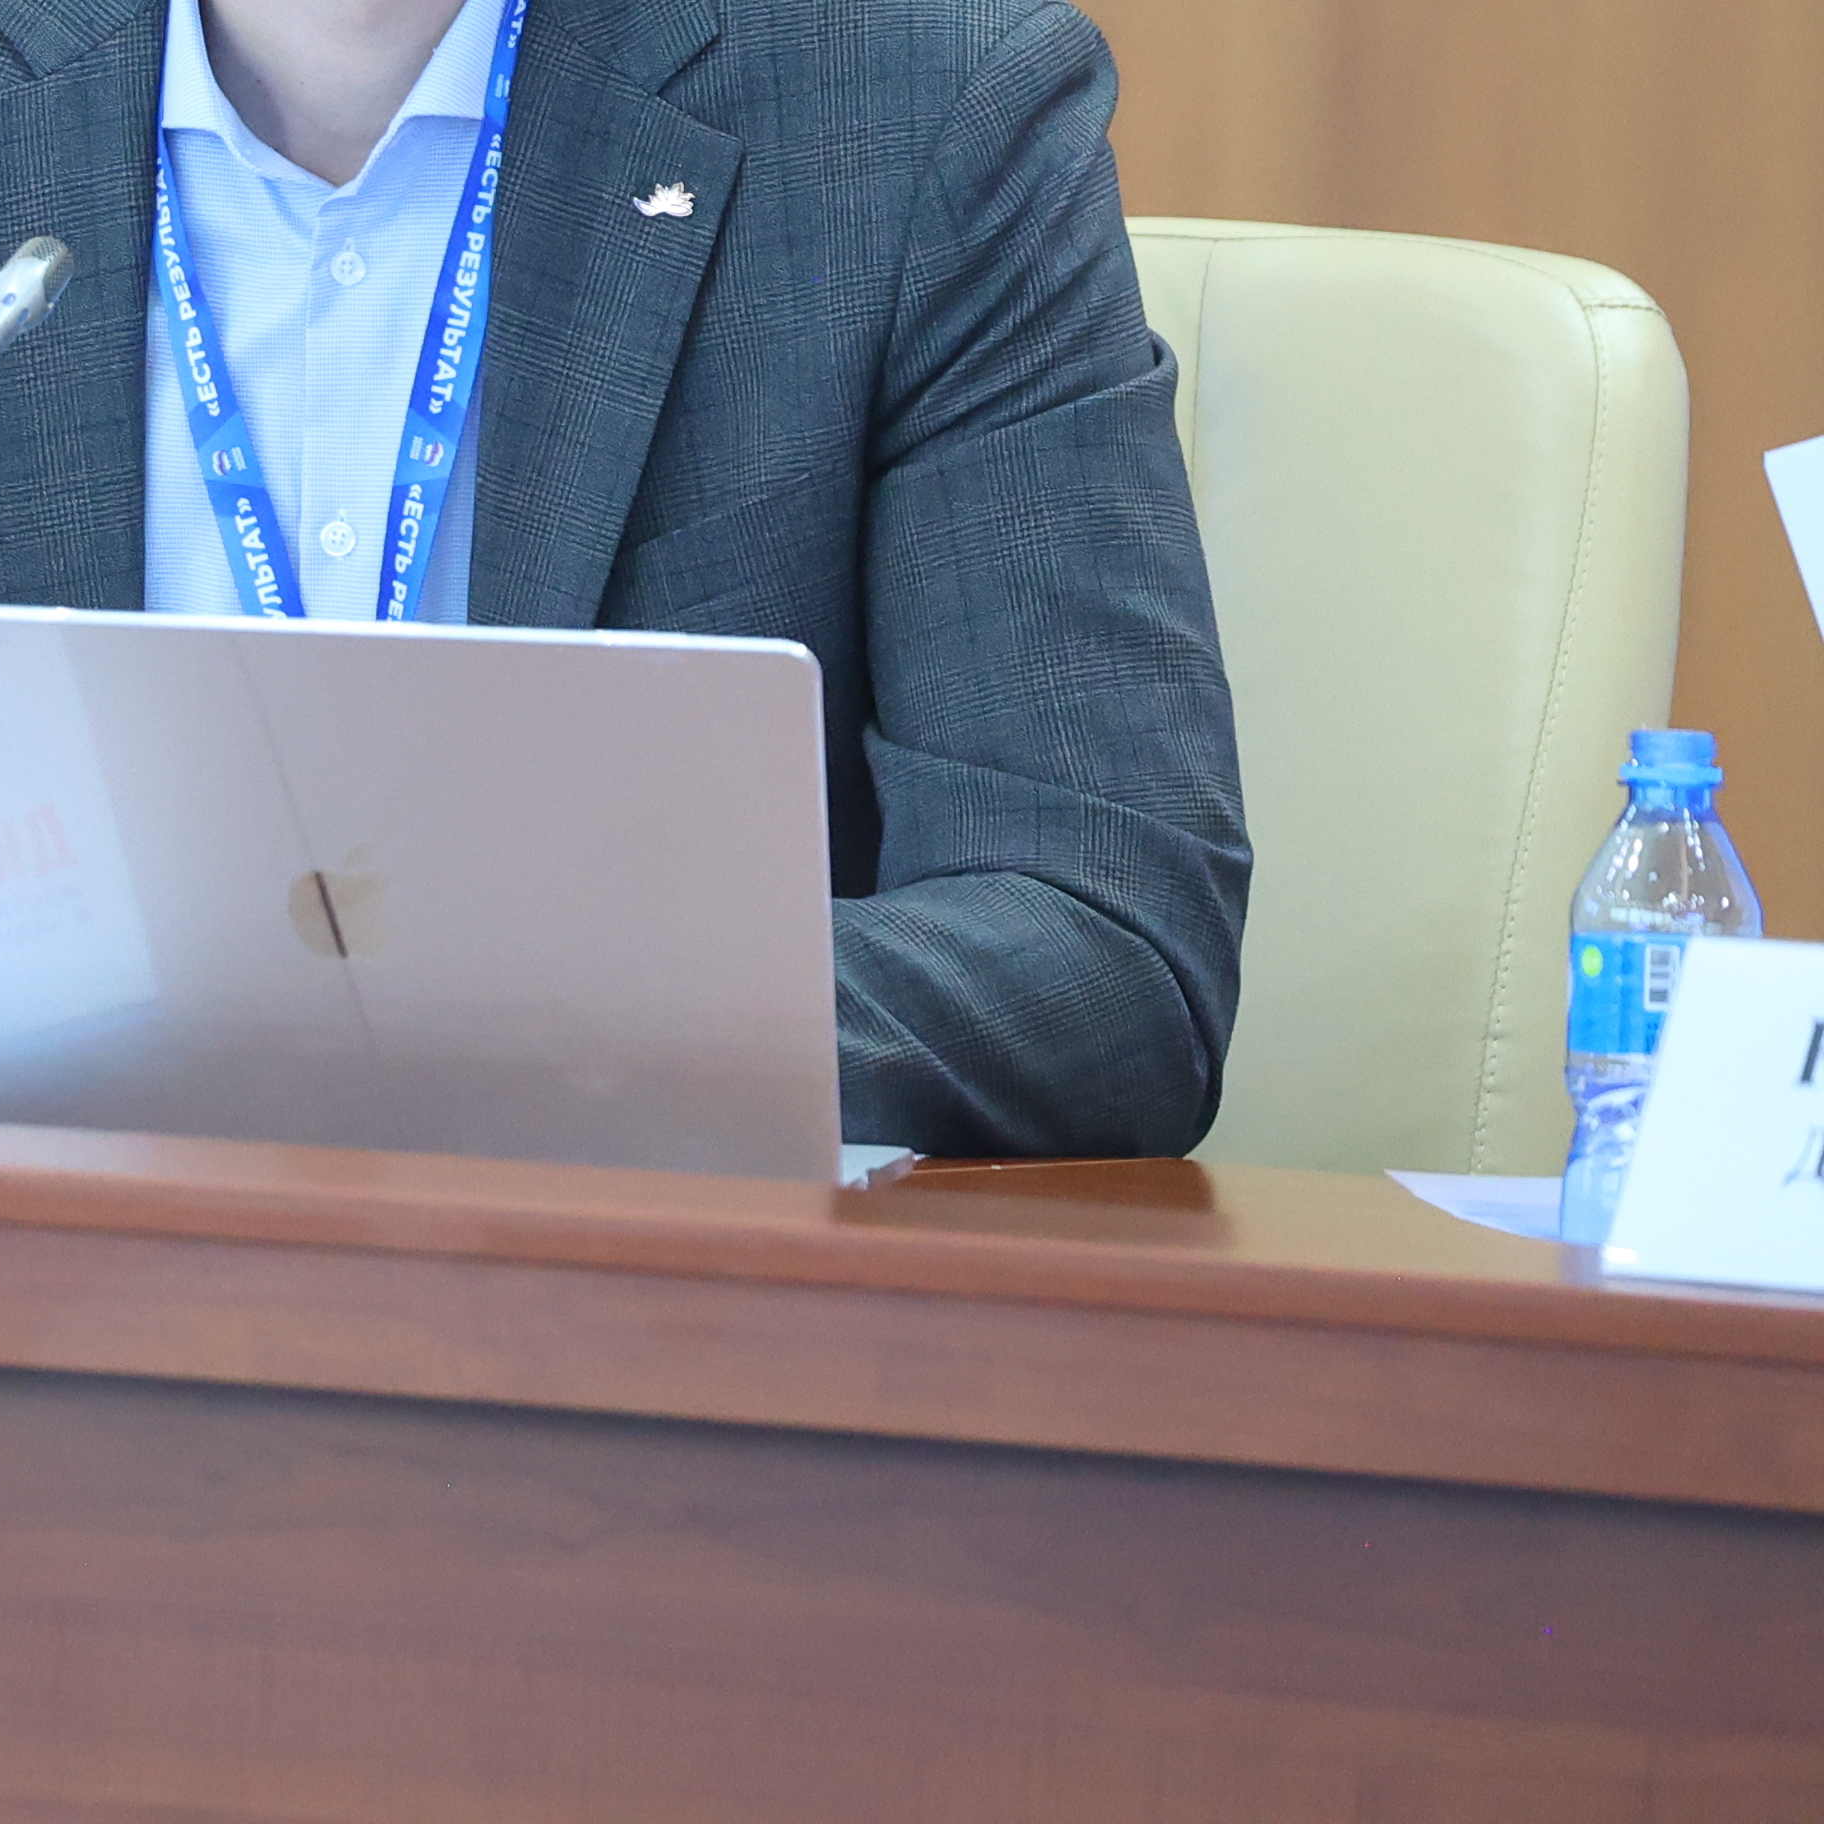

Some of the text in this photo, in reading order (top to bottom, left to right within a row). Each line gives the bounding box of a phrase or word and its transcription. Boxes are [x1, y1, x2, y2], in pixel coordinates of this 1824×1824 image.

[156, 157, 221, 417] «ЕСТЬ РЕЗУЛЬТА
[429, 133, 503, 414] «ЕСТЬ РЕЗУЛЬТАТ»
[387, 580, 408, 622] РЕ
[394, 483, 425, 574] «ЕСТЬ
